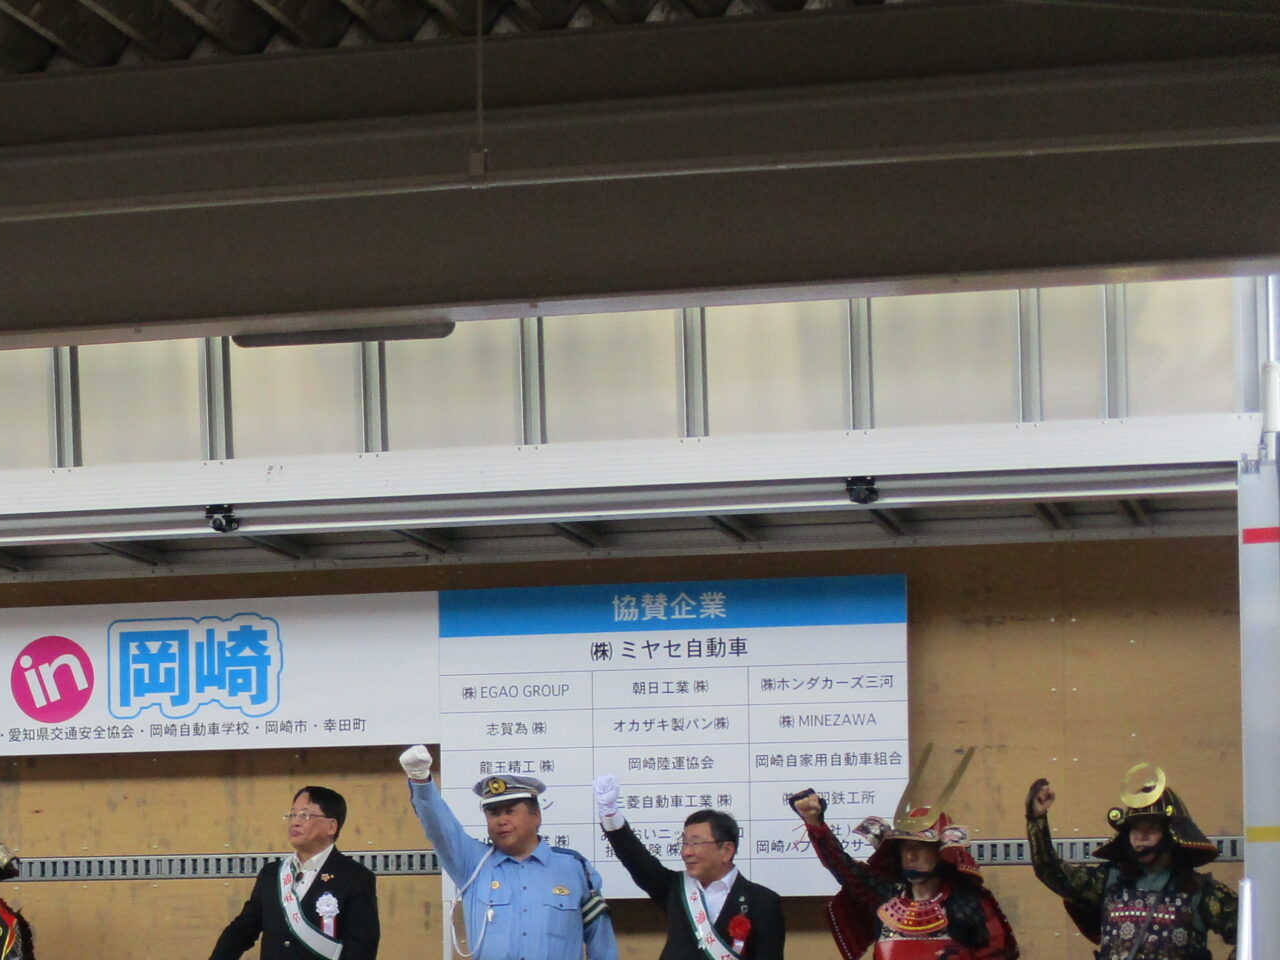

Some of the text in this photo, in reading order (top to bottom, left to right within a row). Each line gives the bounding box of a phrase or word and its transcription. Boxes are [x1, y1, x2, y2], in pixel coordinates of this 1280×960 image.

[612, 591, 728, 622] 協賛企業
[19, 653, 89, 709] in
[119, 624, 272, 708] 岡崎
[480, 685, 519, 699] EGAO
[523, 683, 570, 698] GROUP
[798, 713, 877, 727] MINEZAWA
[628, 755, 715, 771] 岡崎陸運協会
[755, 751, 903, 768] 岡崎自家用自動車組合
